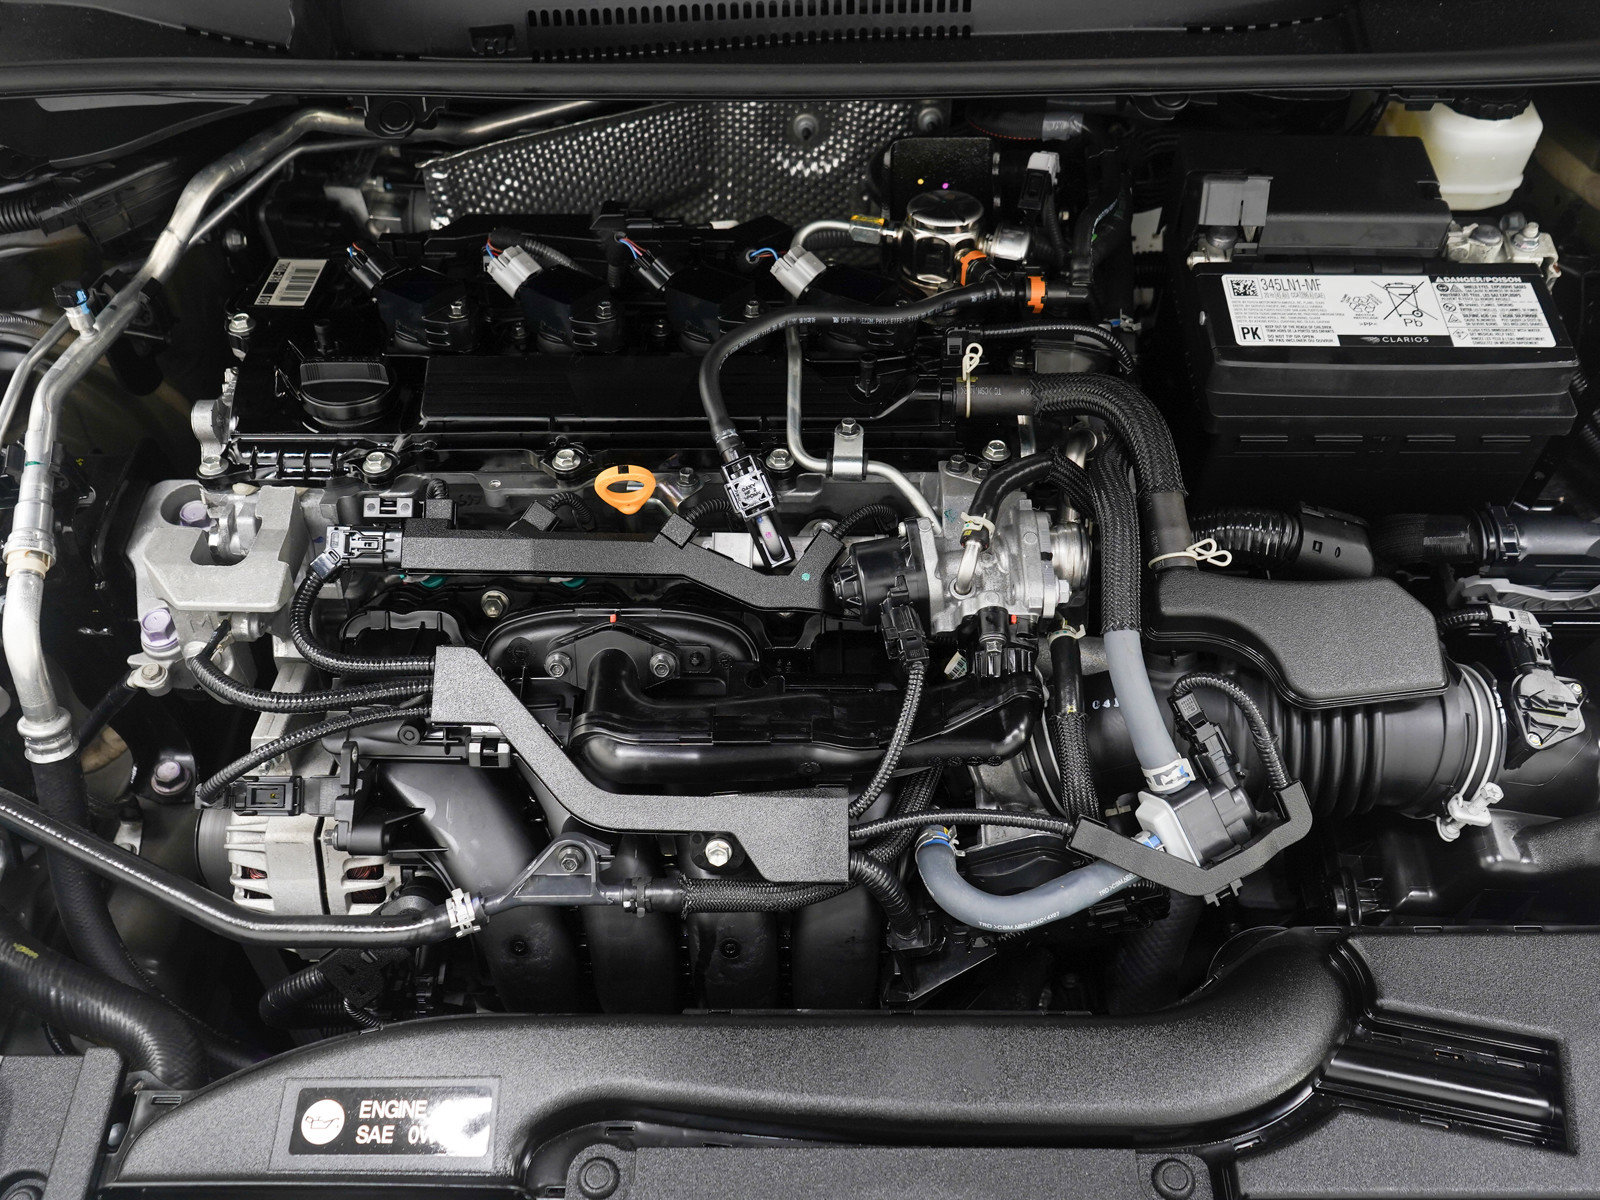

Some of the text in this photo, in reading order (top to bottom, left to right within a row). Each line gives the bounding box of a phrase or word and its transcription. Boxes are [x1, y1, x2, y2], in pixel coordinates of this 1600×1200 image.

[1260, 278, 1322, 291] 345LN1-MF
[1403, 318, 1424, 328] Pb
[1241, 327, 1262, 340] PK
[358, 1100, 428, 1119] ENGINE
[355, 1124, 394, 1144] SAE
